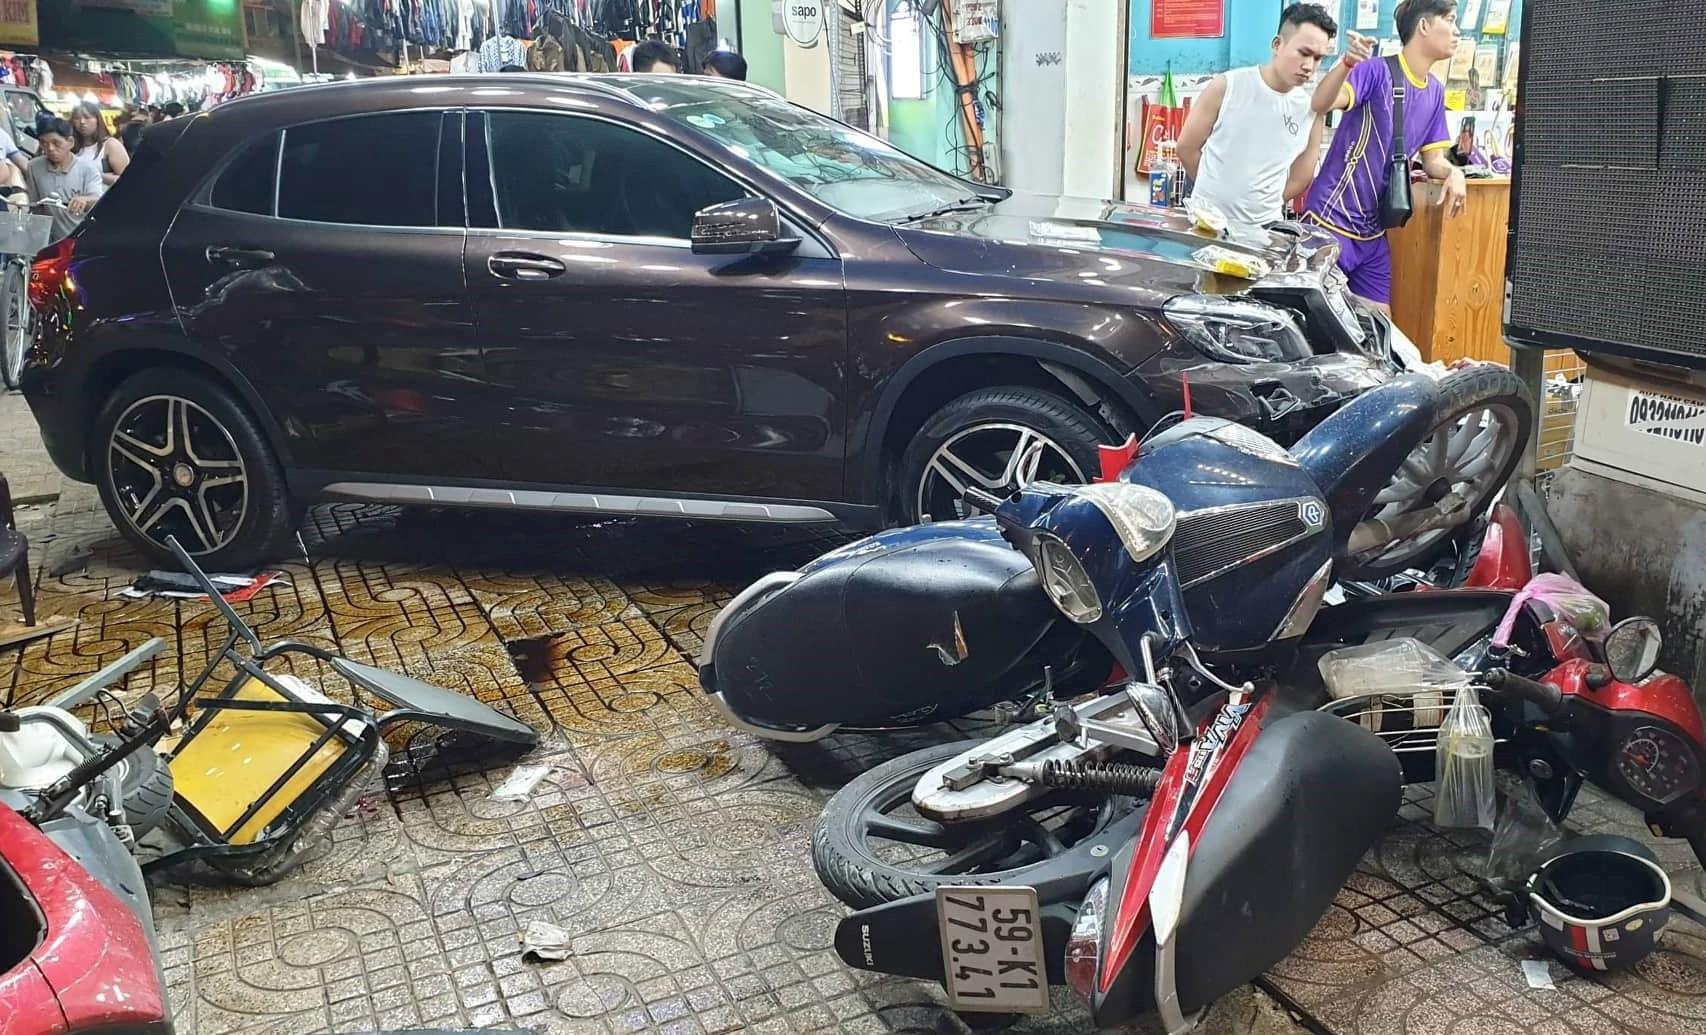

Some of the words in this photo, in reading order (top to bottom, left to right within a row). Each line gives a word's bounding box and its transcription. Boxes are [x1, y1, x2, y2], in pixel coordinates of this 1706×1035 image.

[792, 6, 817, 20] sapo
[861, 924, 874, 966] SUZUKI
[945, 896, 996, 999] 773.41
[991, 908, 1040, 989] 59-K1
